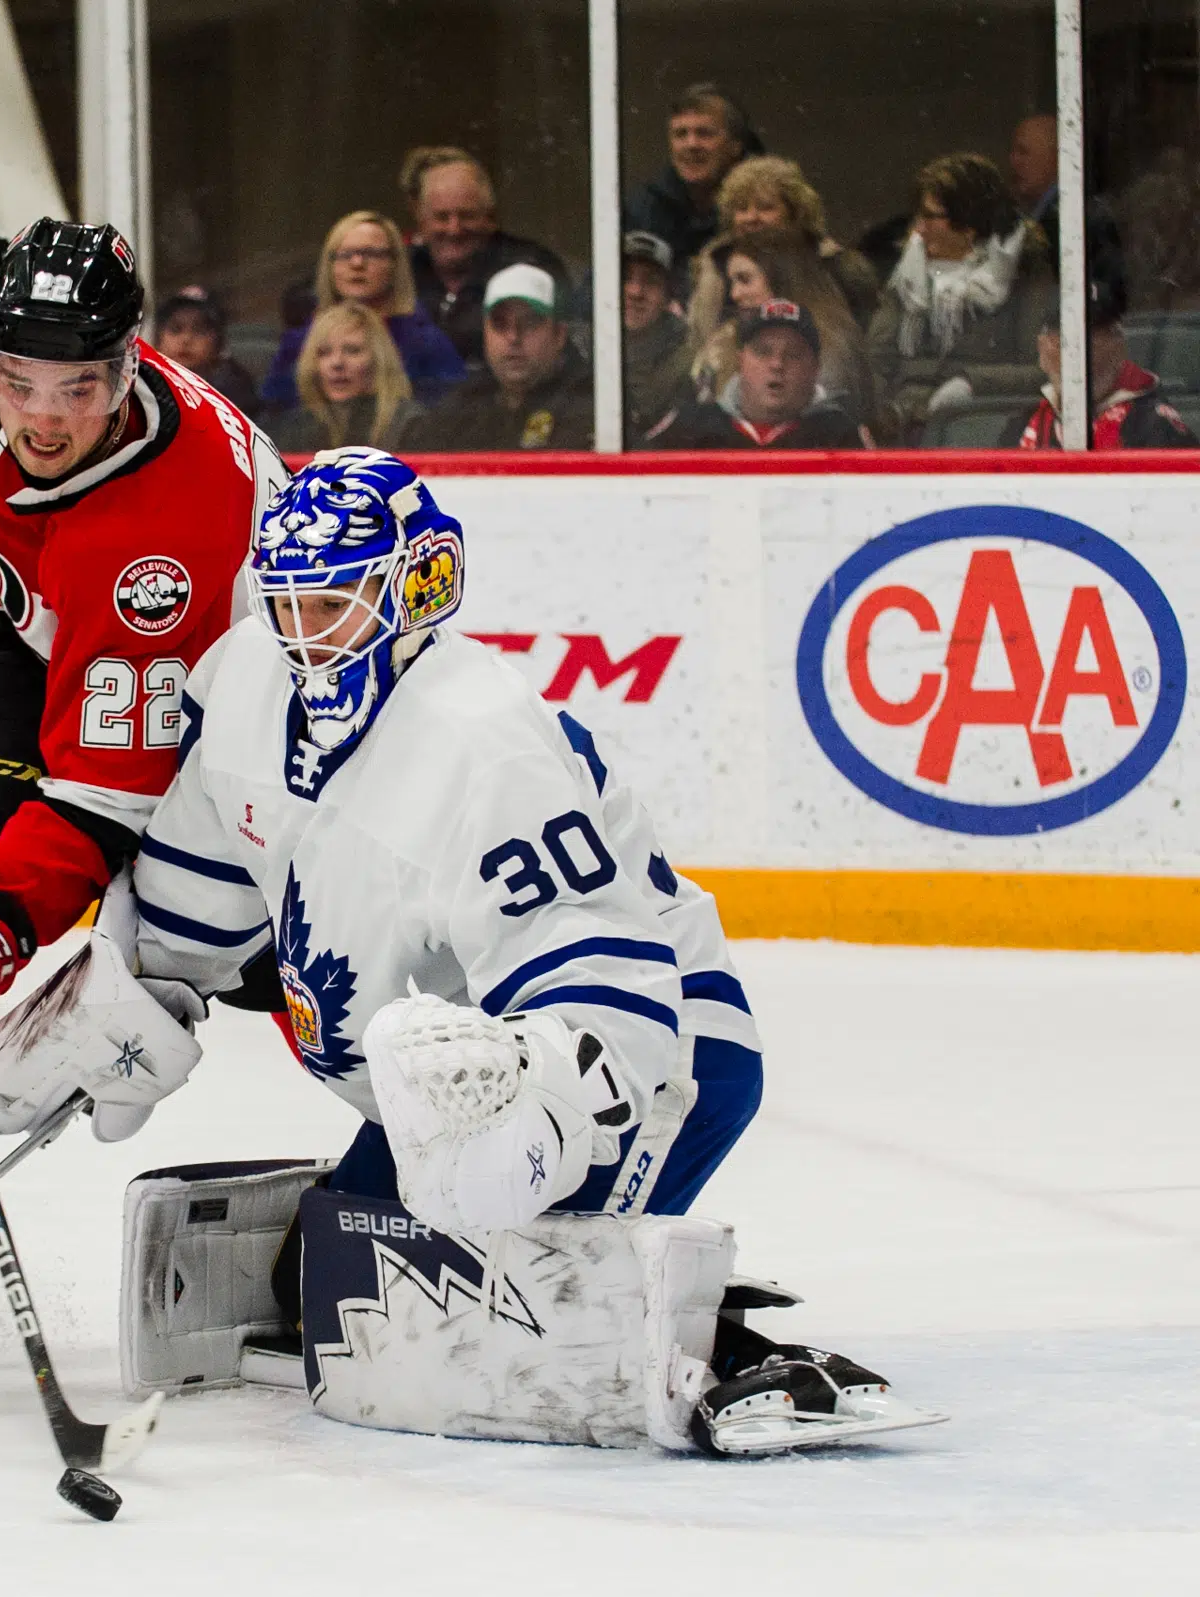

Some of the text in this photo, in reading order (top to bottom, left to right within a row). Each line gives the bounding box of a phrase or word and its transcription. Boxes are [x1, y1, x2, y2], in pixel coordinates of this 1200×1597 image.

[30, 270, 74, 304] 22
[127, 562, 180, 582] BELLEVILLE
[132, 611, 180, 630] SENATORS
[846, 549, 1140, 788] CAA
[80, 656, 190, 750] 22
[479, 809, 618, 918] 30
[616, 1149, 655, 1214] CCM
